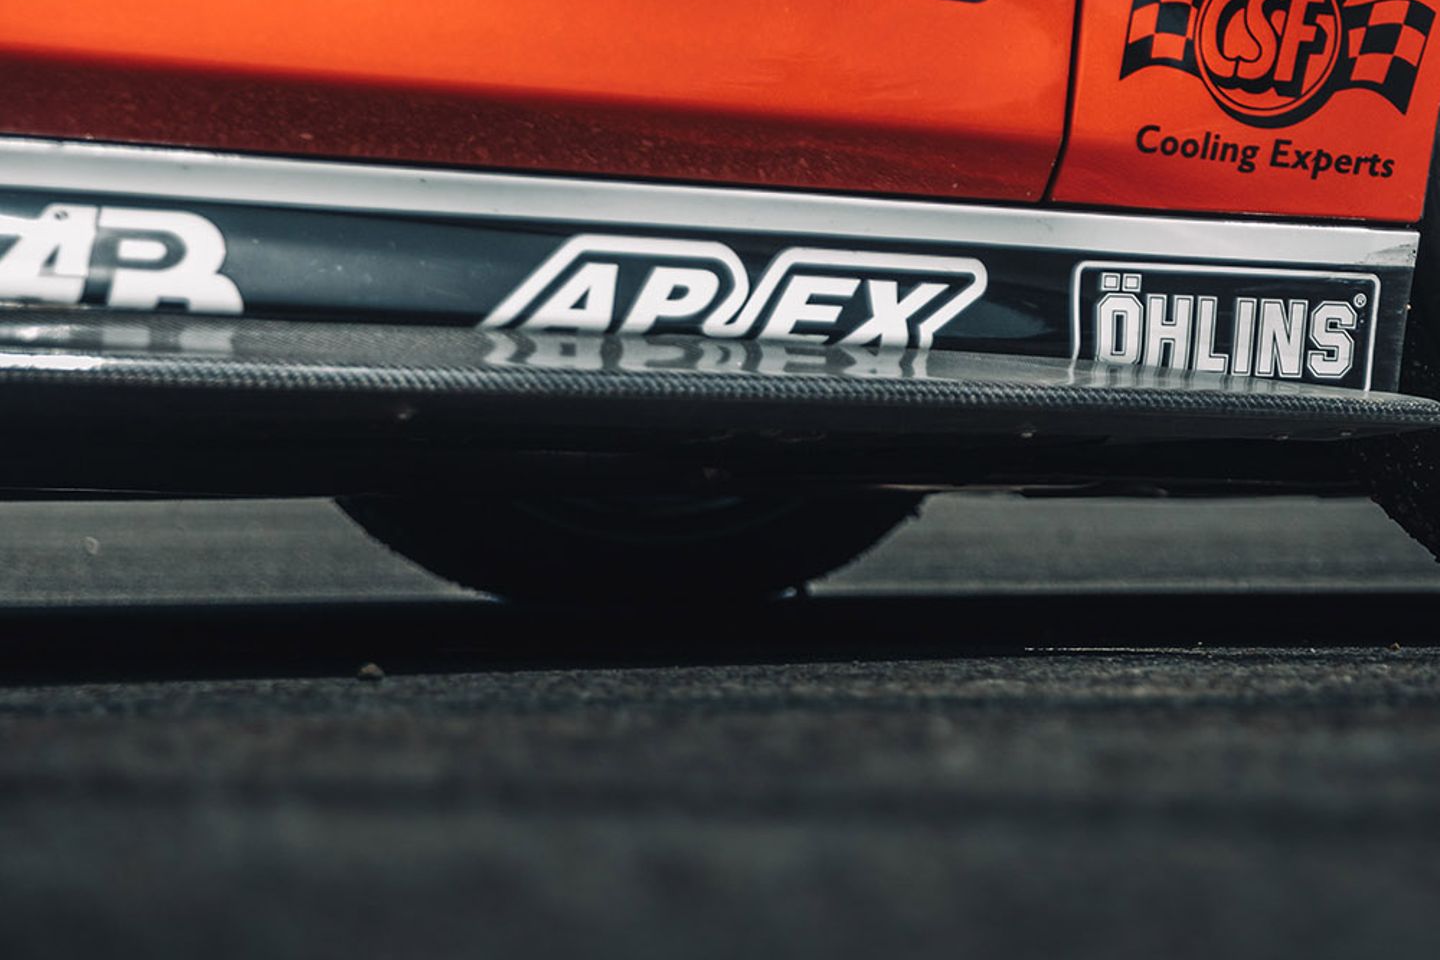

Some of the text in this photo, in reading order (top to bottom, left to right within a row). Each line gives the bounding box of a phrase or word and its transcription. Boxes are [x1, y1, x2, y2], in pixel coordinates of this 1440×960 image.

[1136, 124, 1396, 180] Cooling Experts
[518, 261, 950, 348] APEX
